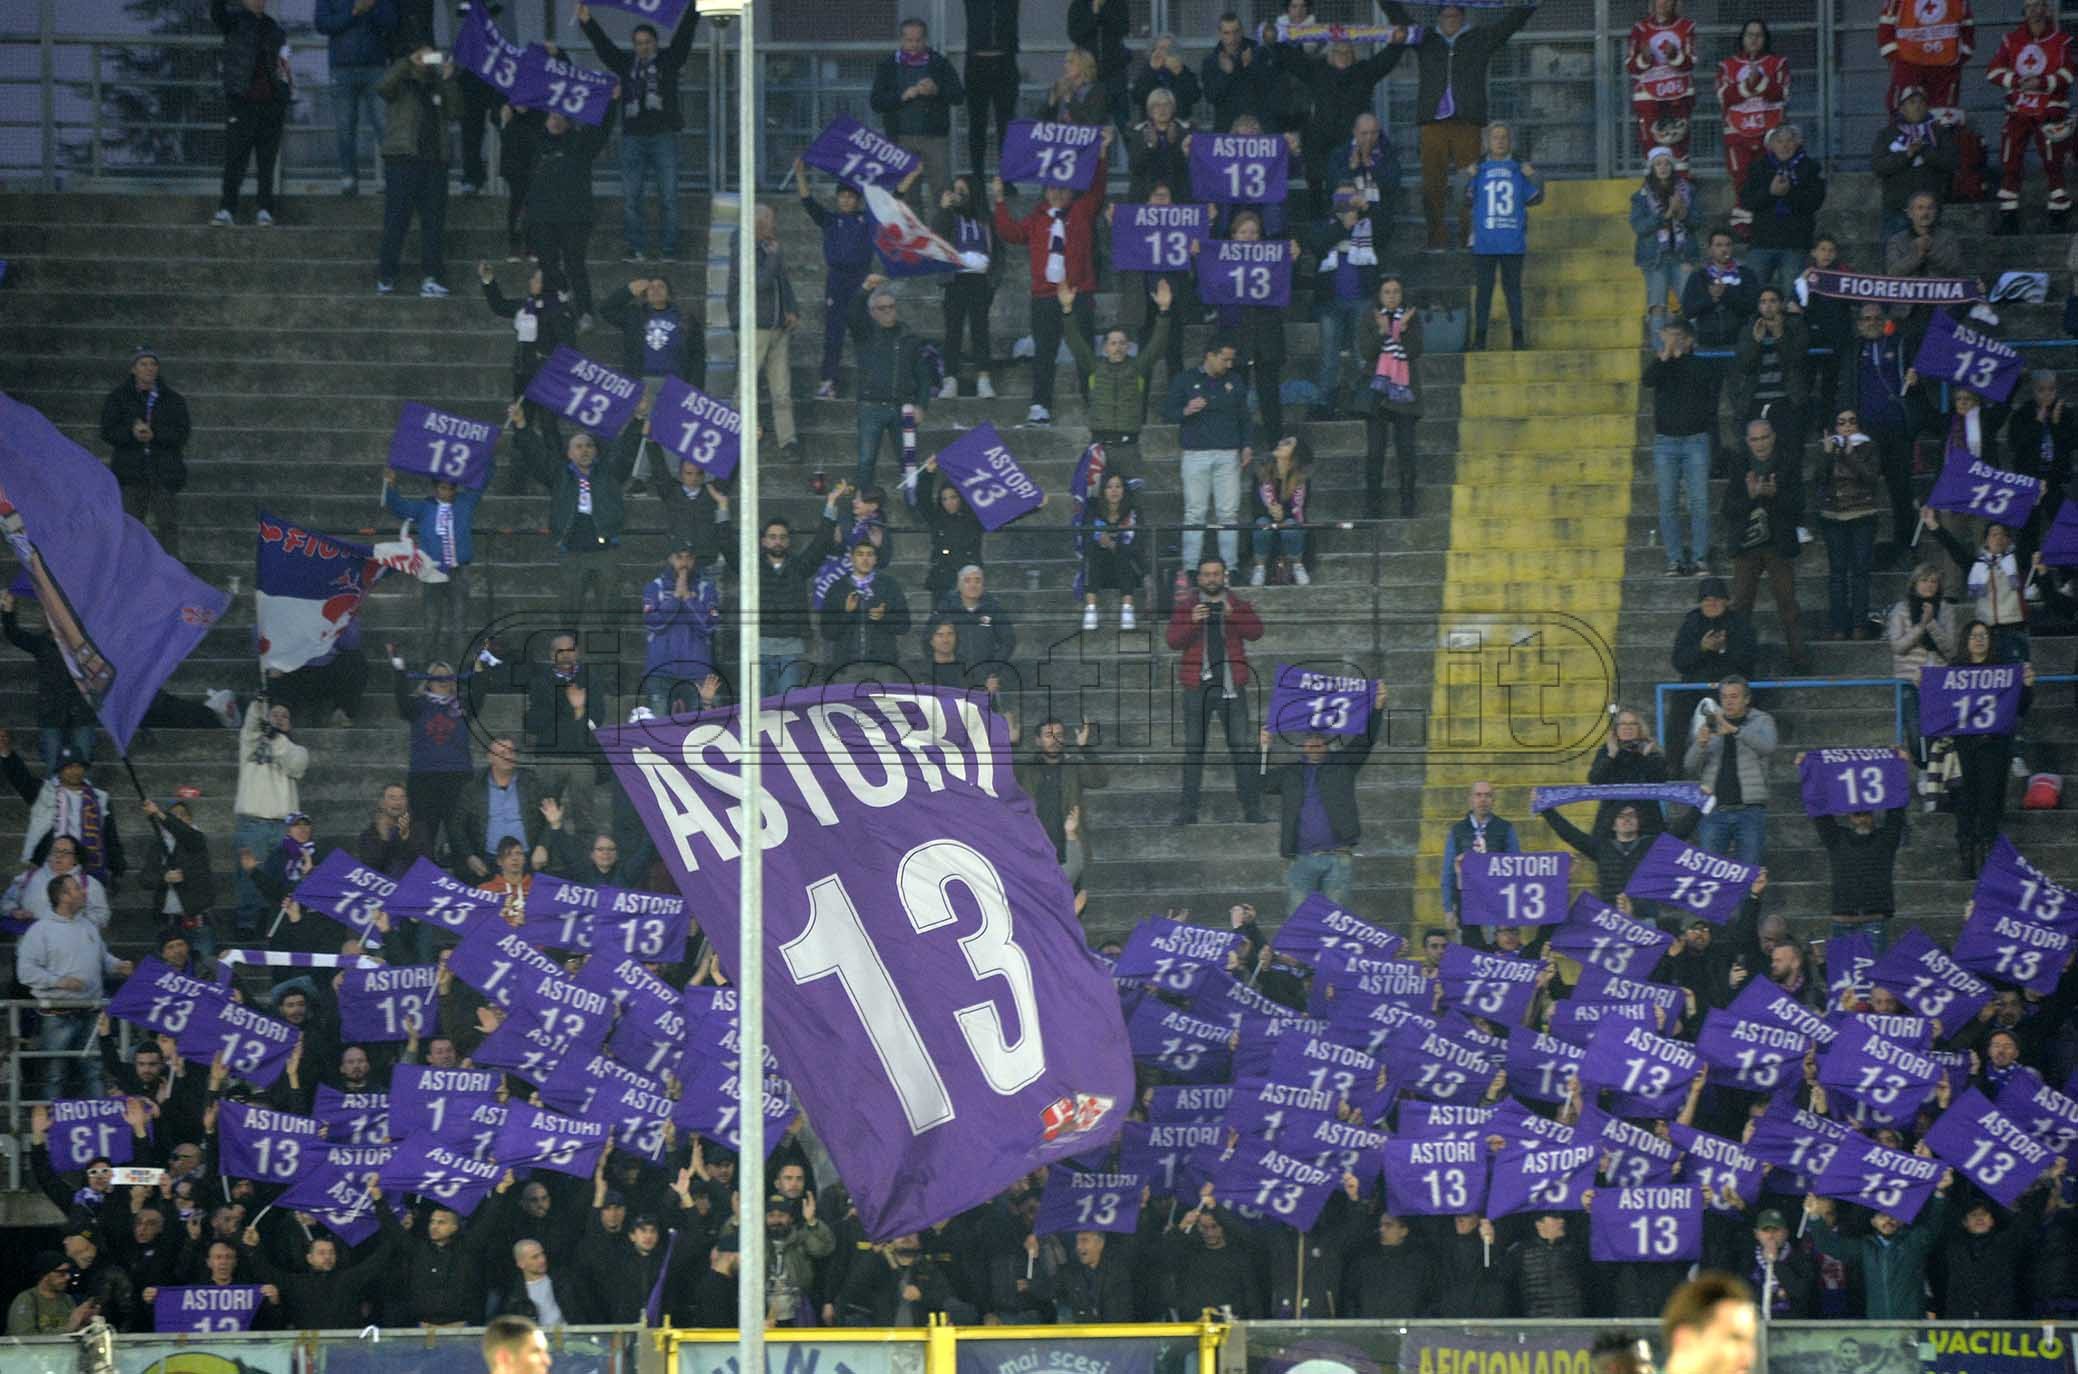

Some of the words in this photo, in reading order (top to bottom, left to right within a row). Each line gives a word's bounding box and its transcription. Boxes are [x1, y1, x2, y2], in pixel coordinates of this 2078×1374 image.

[548, 81, 590, 113] 13
[850, 128, 910, 169] ASTORI
[1031, 122, 1096, 145] ASTORI
[1213, 138, 1277, 157] ASTORI
[840, 152, 884, 185] 13
[1036, 148, 1076, 181] 13
[1224, 165, 1266, 197] 13
[1484, 180, 1514, 216] 13
[1136, 208, 1199, 226] ASTORI
[1146, 232, 1188, 265] 13
[1219, 243, 1282, 262] ASTORI
[1229, 267, 1271, 299] 13
[1839, 278, 1964, 298] FIORENTINA
[570, 359, 635, 398] ASTORI
[1953, 351, 2000, 388] 13
[565, 384, 611, 427] 13
[424, 412, 489, 440] ASTORI
[679, 421, 722, 463] 13
[428, 440, 470, 477] 13
[983, 445, 1038, 499] ASTORI
[1968, 462, 2035, 488] ASTORI
[963, 469, 1007, 507] 13
[1968, 484, 2016, 514] 13
[1300, 673, 1367, 692] ASTORI
[1943, 669, 2013, 690] ASTORI
[1307, 697, 1351, 728] 13
[1953, 695, 1996, 729] 13
[632, 693, 999, 872] ASTORI
[1838, 767, 1885, 805] 13
[344, 867, 398, 896] ASTO
[1488, 856, 1558, 877] ASTORI
[1674, 848, 1750, 883] ASTORI
[334, 891, 384, 925] 13
[612, 893, 684, 914] ASTORI
[1500, 884, 1545, 920] 13
[1670, 876, 1721, 908] 13
[2019, 880, 2067, 921] 13
[426, 896, 477, 925] 13
[1592, 909, 1663, 945] ASTORI
[618, 918, 665, 956] 13
[1322, 910, 1395, 948] ASTORI
[1994, 916, 2069, 950] ASTORI
[1587, 937, 1636, 974] 13
[1995, 945, 2043, 981] 13
[365, 967, 436, 992] ASTORI
[778, 838, 1046, 1136] 13
[1152, 958, 1200, 989] 13
[1920, 948, 1987, 998] ASTORI
[536, 976, 607, 1016] ASTORI
[1461, 979, 1510, 1012] 13
[1905, 976, 1955, 1016] 13
[147, 995, 195, 1032] 13
[219, 1001, 289, 1042] ASTORI
[376, 993, 424, 1034] 13
[1767, 997, 1840, 1044] ASTORI
[219, 1033, 266, 1073] 13
[1624, 1026, 1697, 1070] ASTORI
[1731, 1020, 1806, 1052] ASTORI
[1304, 1038, 1376, 1070] ASTORI
[1735, 1048, 1783, 1087] 13
[1861, 1034, 1935, 1080] ASTORI
[418, 1070, 492, 1091] ASTORI
[1416, 1063, 1466, 1097] 13
[1622, 1057, 1671, 1098] 13
[1856, 1066, 1908, 1103] 13
[621, 1088, 672, 1117] ASTO
[1258, 1083, 1333, 1111] ASTORI
[1149, 1126, 1220, 1147] ASTORI
[1410, 1142, 1476, 1164] ASTORI
[1978, 1110, 2049, 1164] ASTORI
[252, 1136, 300, 1177] 13
[1258, 1150, 1332, 1185] ASTORI
[1522, 1144, 1595, 1174] ASTORI
[1789, 1136, 1839, 1175] 13
[1862, 1147, 1938, 1180] ASTORI
[1963, 1139, 2016, 1184] 13
[1255, 1178, 1304, 1214] 13
[1422, 1169, 1468, 1207] 13
[1618, 1188, 1692, 1209] ASTORI
[1860, 1173, 1908, 1206] 13
[1077, 1192, 1121, 1225] 13
[1630, 1215, 1678, 1255] 13
[182, 1290, 253, 1311] ASTORI
[1928, 1329, 2064, 1360] VACILLO
[1050, 1350, 1111, 1374] scesi
